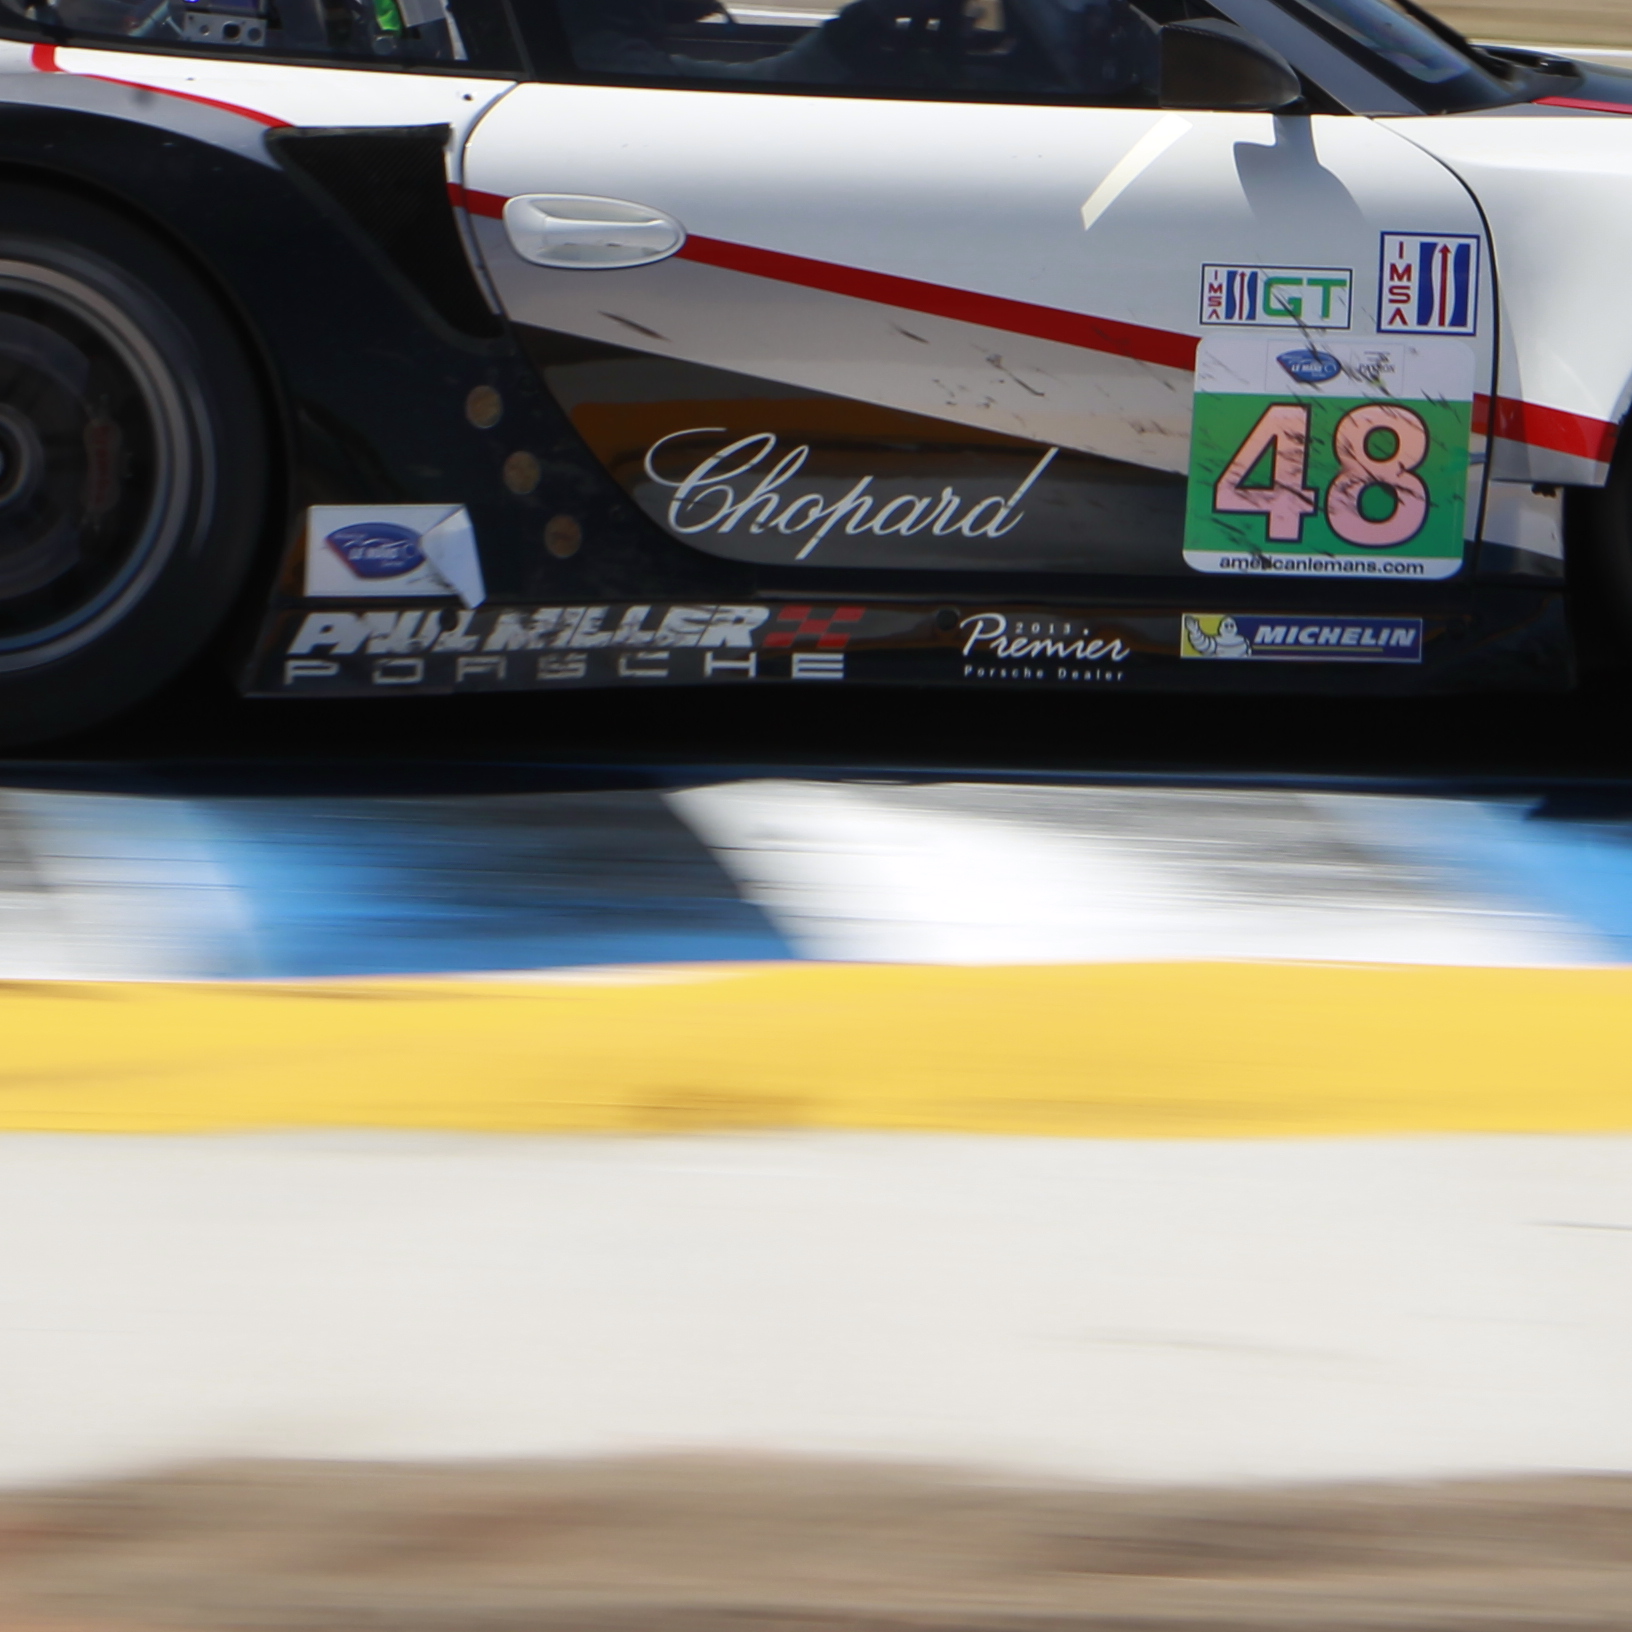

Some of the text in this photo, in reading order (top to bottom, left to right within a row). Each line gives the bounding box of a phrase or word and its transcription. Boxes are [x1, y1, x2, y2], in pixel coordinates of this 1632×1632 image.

[1207, 269, 1224, 320] IMSA
[1262, 276, 1348, 320] GT
[1387, 241, 1412, 327] IMSA
[644, 427, 1058, 560] Chopard
[1213, 402, 1431, 548] 48
[286, 604, 770, 655] PAUL MILLER
[959, 612, 1130, 663] Premier
[1253, 624, 1417, 648] MICHELIN
[284, 651, 845, 685] PORSCHE
[964, 664, 1126, 682] Porsche Dealer
